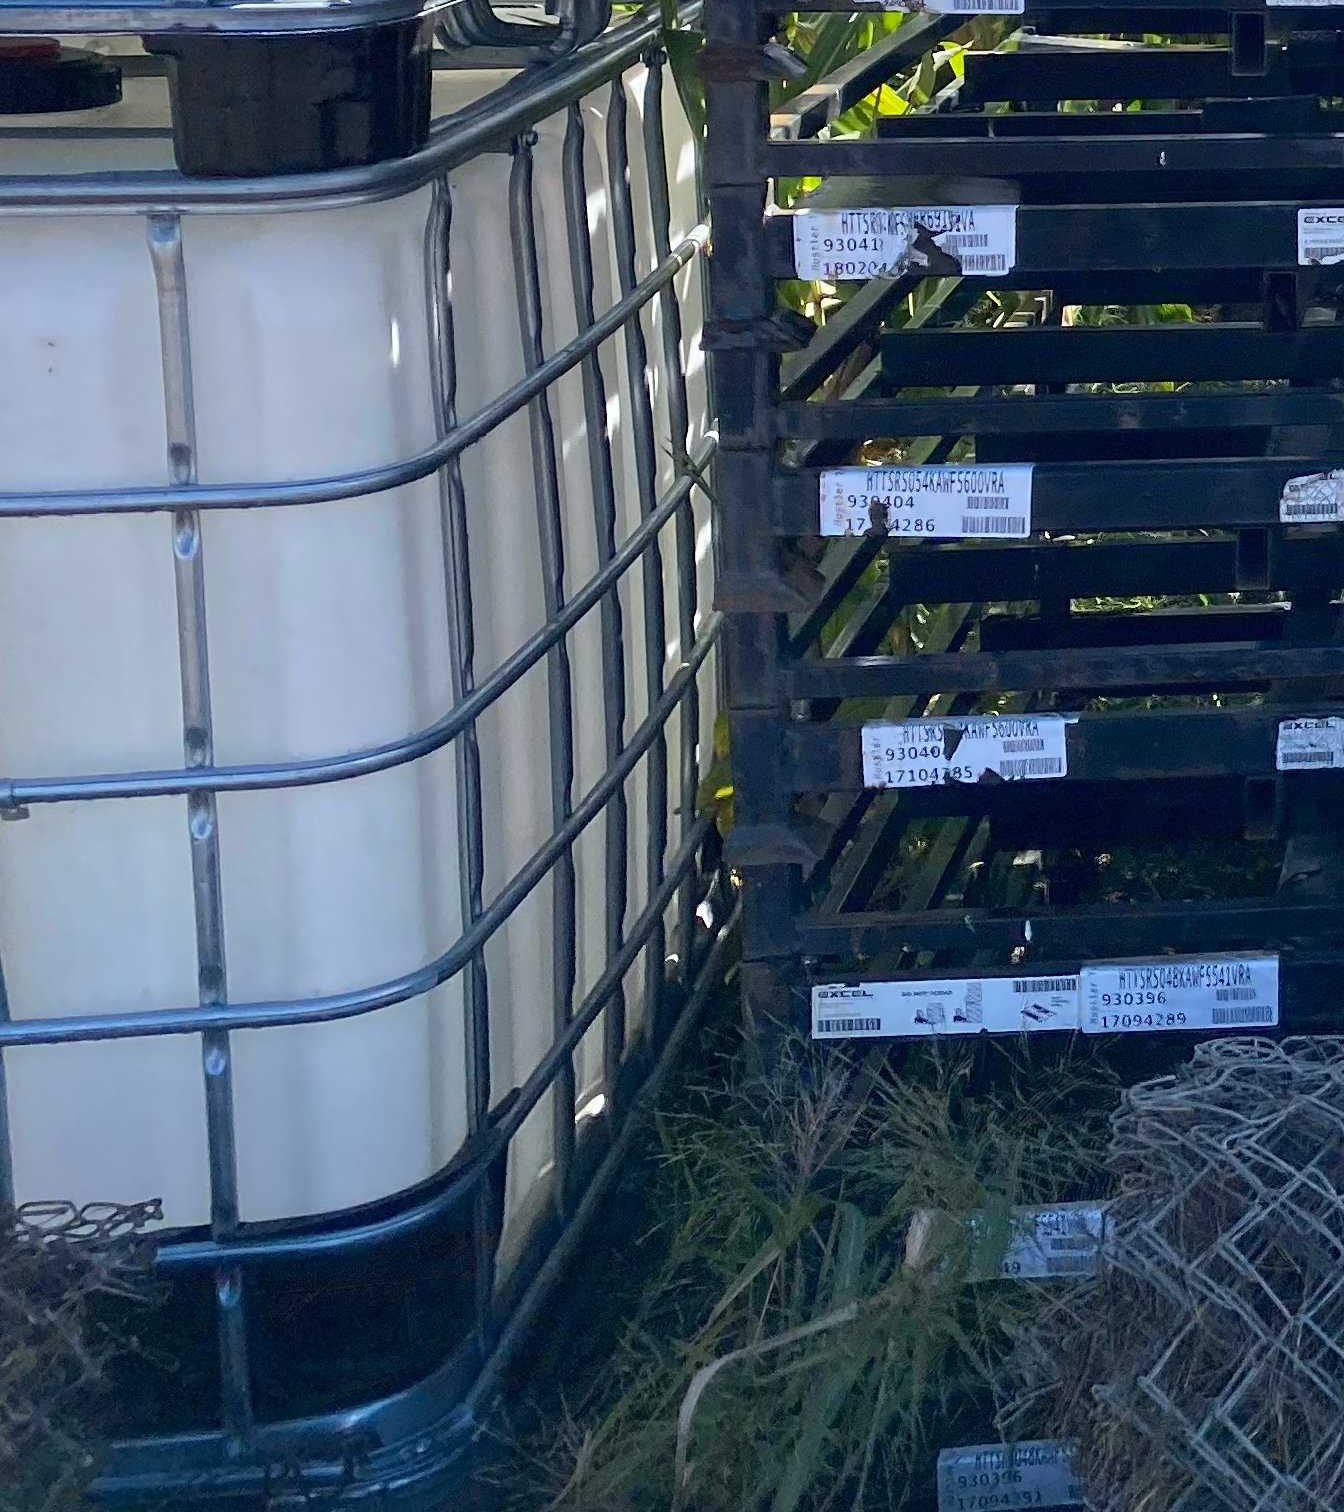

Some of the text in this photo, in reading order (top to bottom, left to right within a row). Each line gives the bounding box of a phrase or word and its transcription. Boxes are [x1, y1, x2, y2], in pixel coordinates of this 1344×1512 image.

[845, 517, 936, 533] 174286
[885, 745, 942, 762] 93040
[817, 989, 875, 999] EXCEL
[1101, 991, 1167, 1007] 930396
